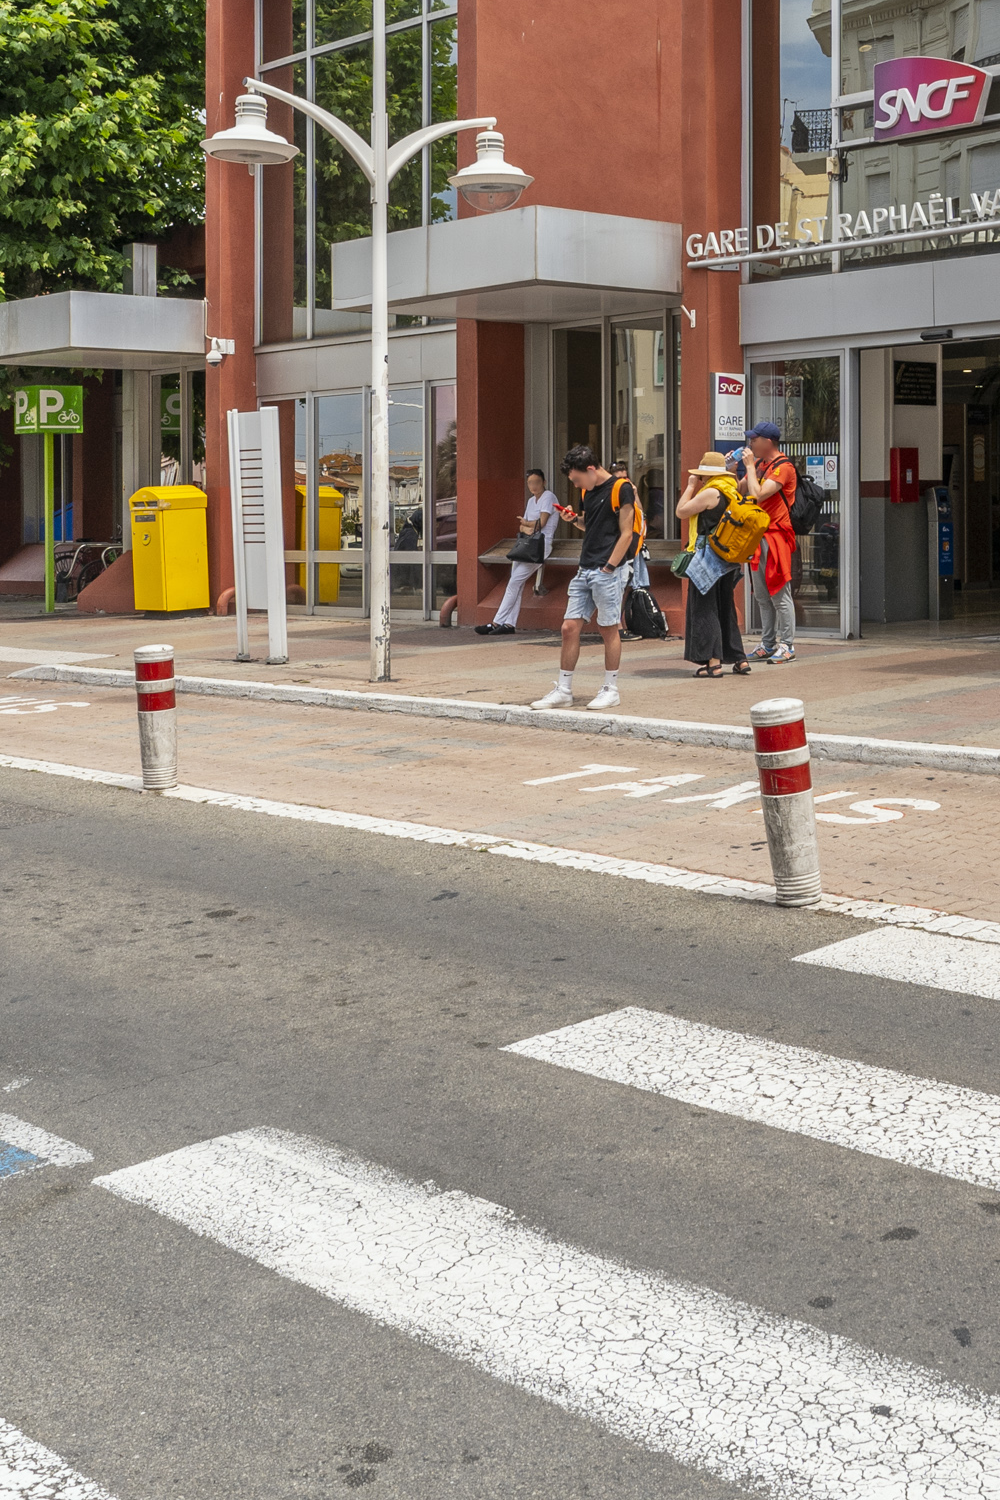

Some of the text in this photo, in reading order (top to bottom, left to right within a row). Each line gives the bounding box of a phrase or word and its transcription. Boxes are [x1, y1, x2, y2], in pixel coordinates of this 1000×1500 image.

[875, 75, 976, 130] SNCF
[686, 227, 749, 259] GARE
[757, 222, 791, 250] DE
[797, 216, 829, 244] ST
[719, 382, 743, 394] SNCF
[15, 390, 29, 425] P
[39, 389, 65, 424] P
[718, 415, 744, 426] GARE
